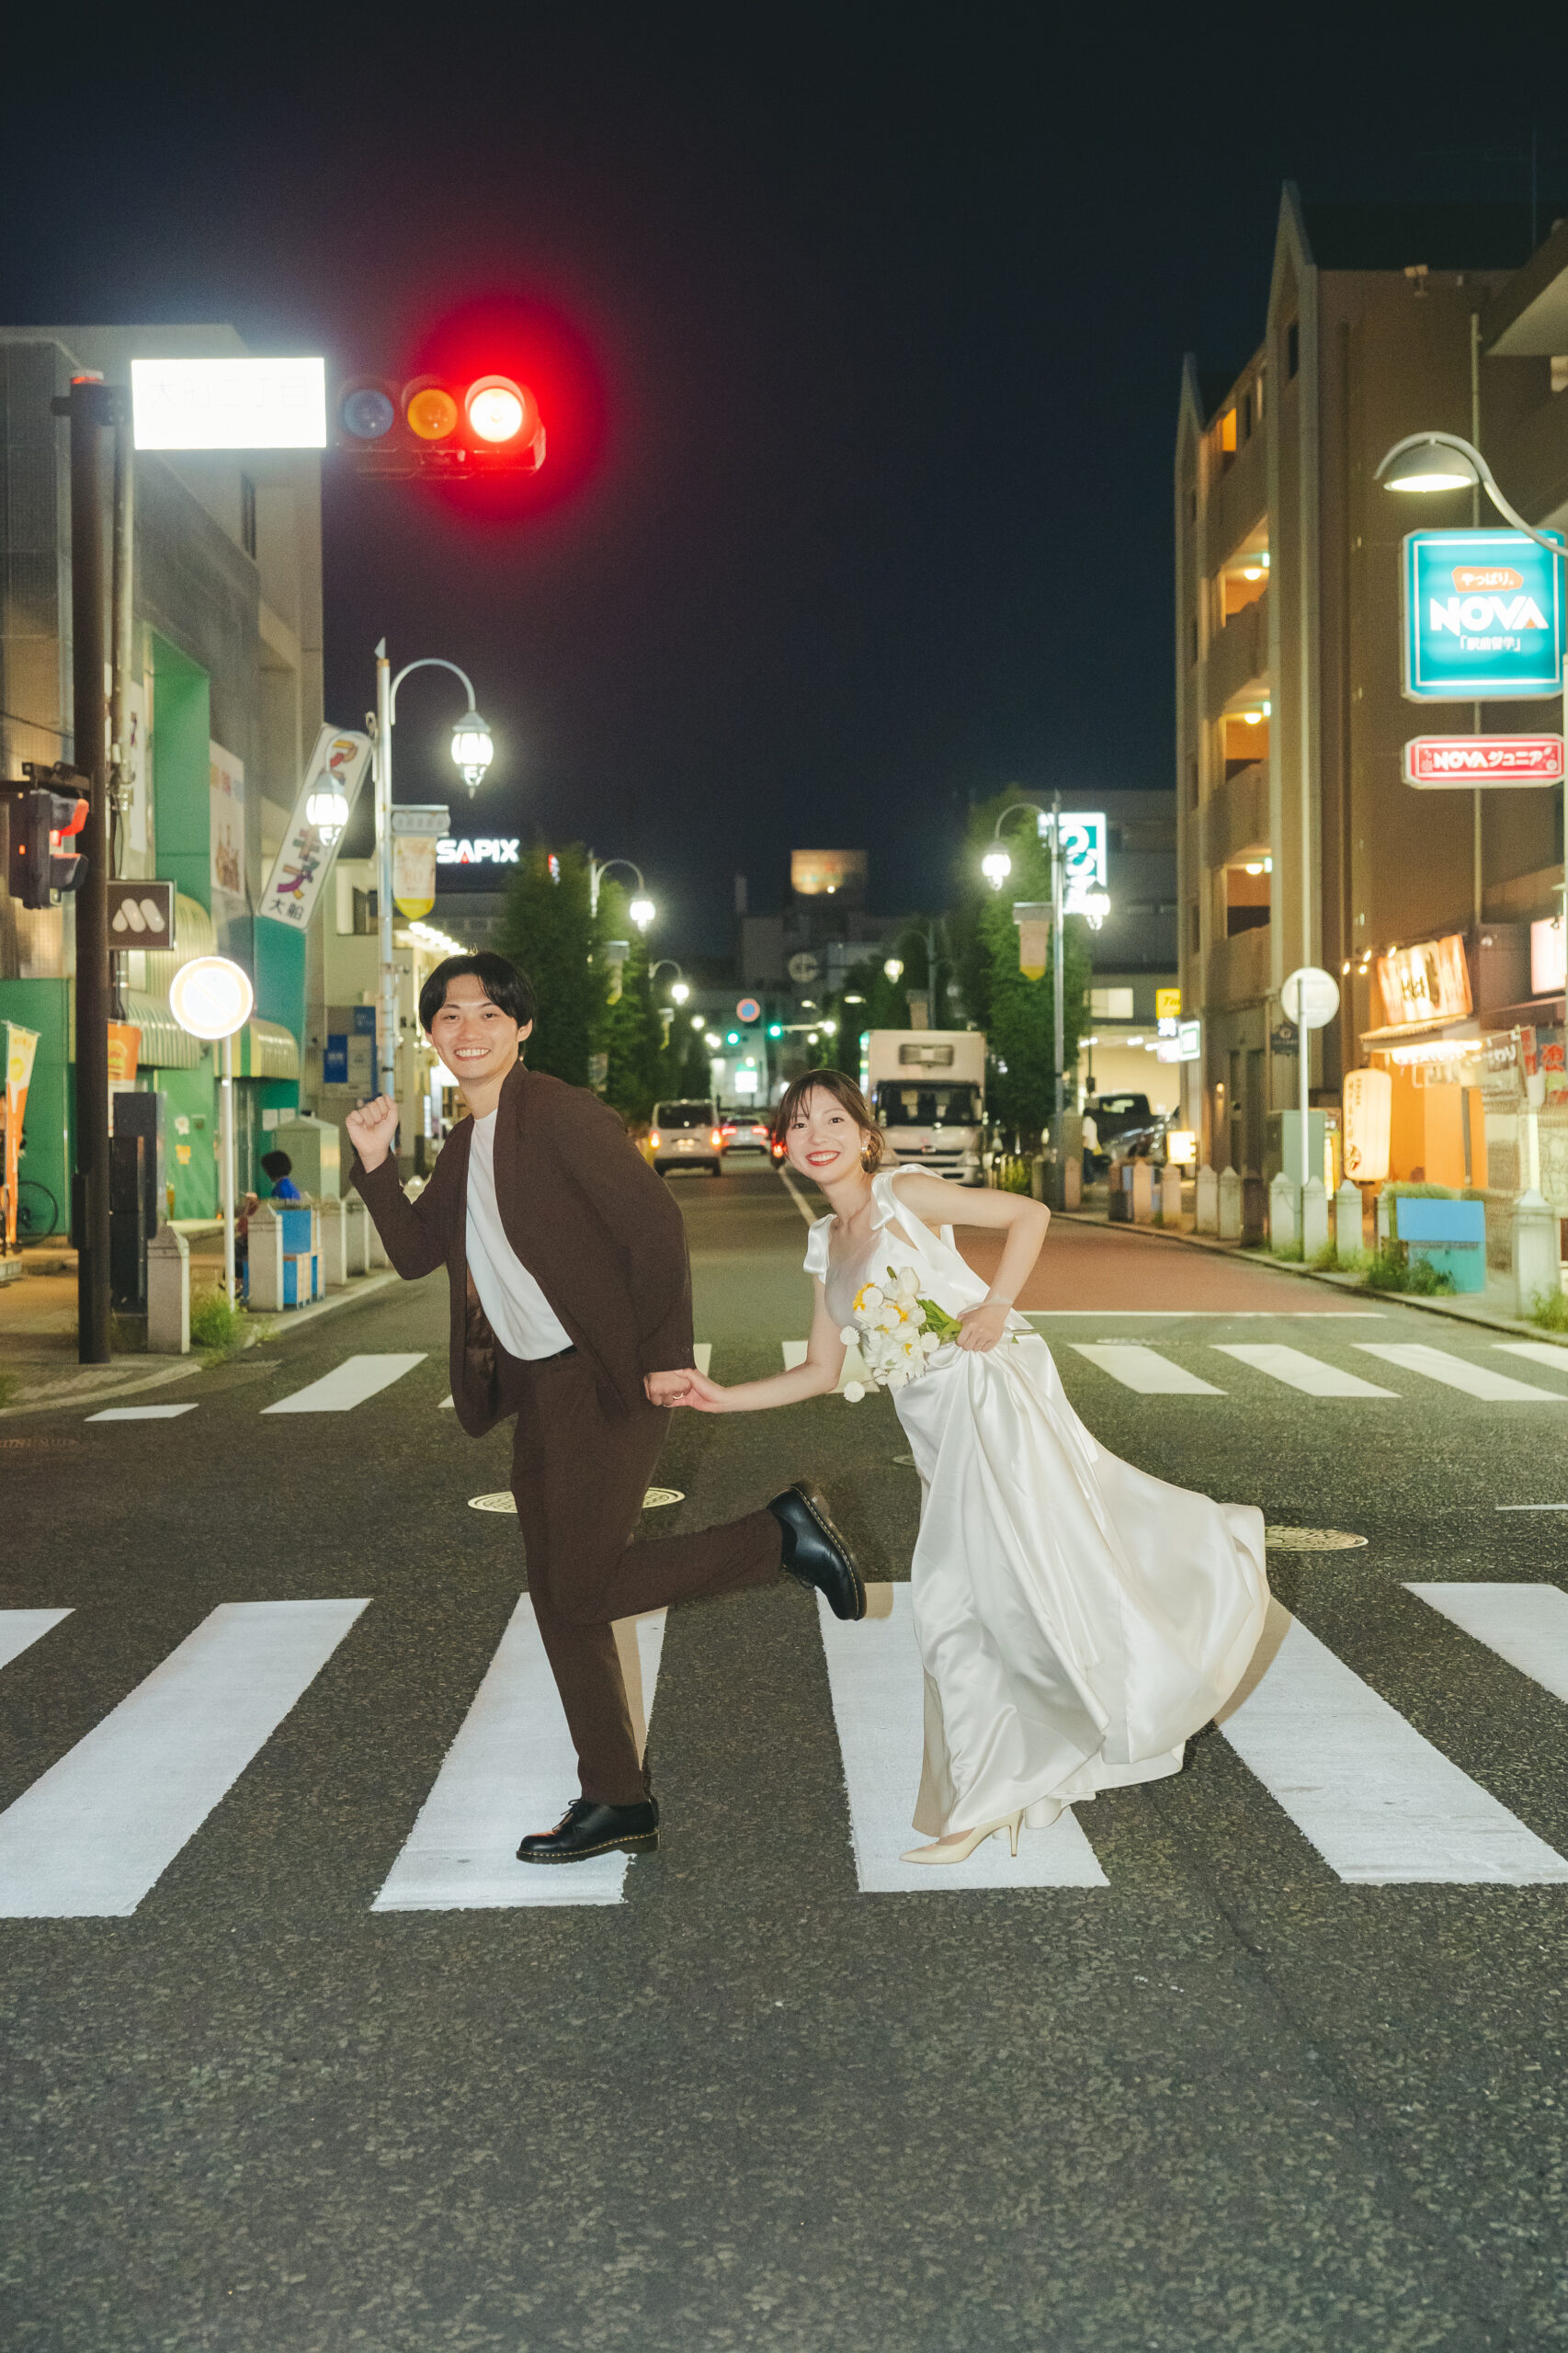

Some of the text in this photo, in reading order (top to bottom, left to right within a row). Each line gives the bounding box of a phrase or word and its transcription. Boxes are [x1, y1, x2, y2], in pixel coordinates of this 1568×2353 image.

[1429, 596, 1549, 636] NOVA
[1433, 750, 1544, 771] NOVAジュニア
[436, 838, 520, 863] SAPIX
[268, 898, 304, 921] 大船
